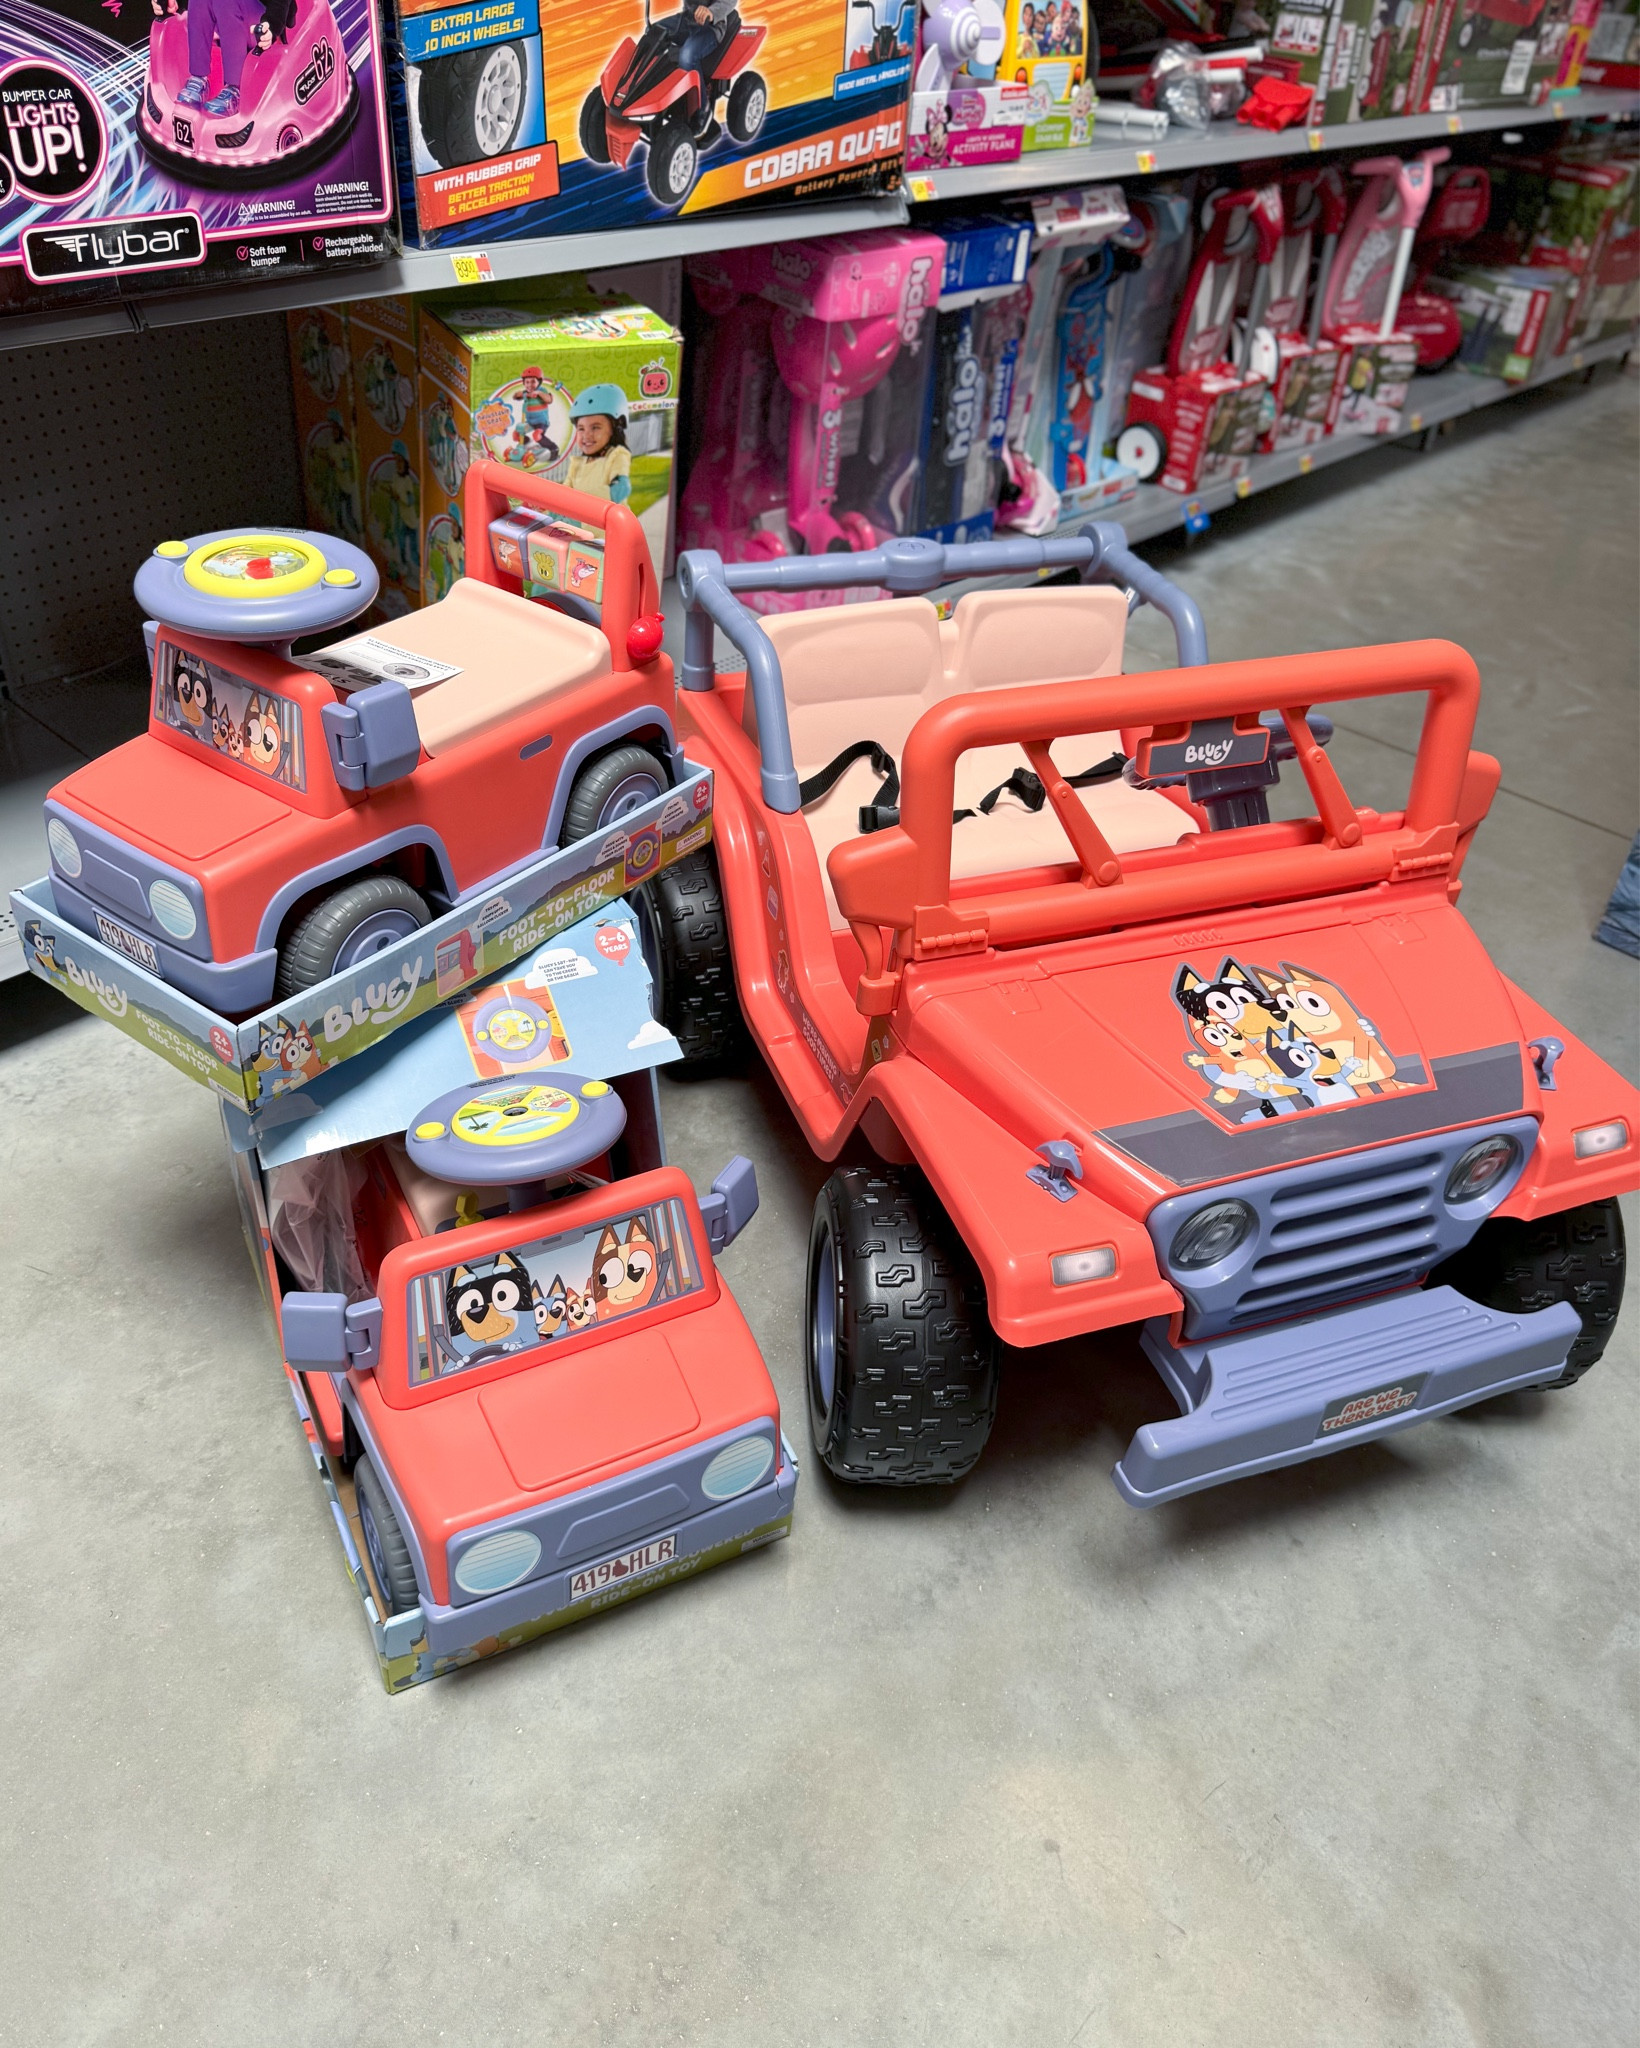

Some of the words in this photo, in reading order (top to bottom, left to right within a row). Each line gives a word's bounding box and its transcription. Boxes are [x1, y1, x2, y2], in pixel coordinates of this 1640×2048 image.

[430, 12, 473, 33] EXTRA
[475, 2, 516, 23] LARGE
[425, 37, 439, 53] 10
[440, 30, 470, 49] INCH
[473, 17, 525, 41] WHEELS!
[2, 89, 47, 103] BUMPER
[48, 88, 73, 101] CAR
[3, 101, 81, 128] LIGHTS
[176, 120, 191, 143] 62
[8, 123, 88, 177] UP!
[952, 140, 989, 155] ACTIVITY
[434, 173, 464, 193] WITH
[465, 161, 513, 184] RUBBER
[514, 153, 542, 172] GRIP
[744, 139, 834, 189] COBRA
[324, 181, 369, 195] WARNING!
[448, 185, 487, 204] BETTER
[488, 172, 535, 193] TRACTION
[448, 206, 457, 216] &
[458, 185, 530, 214] ACCELERATION
[794, 176, 836, 196] Battery
[248, 199, 296, 214] WARNING!
[43, 228, 189, 265] Flybar
[250, 247, 266, 258] Soft
[267, 245, 287, 255] foam
[324, 233, 374, 248] Rechargeable
[326, 247, 352, 258] battery
[352, 242, 384, 254] included
[251, 255, 281, 267] bumper
[902, 256, 934, 344] halo
[947, 358, 979, 462] halo
[1184, 739, 1234, 766] BLUEY
[697, 786, 707, 798] 2+
[498, 867, 616, 946] FOOT-TO-FLOOR
[513, 911, 574, 953] RIDE-ON
[577, 889, 603, 915] TOY
[100, 919, 122, 948] 419
[126, 937, 157, 970] HLR
[598, 931, 626, 947] 2-6
[603, 943, 628, 954] YEARS
[64, 956, 128, 1018] BLUEY
[324, 955, 423, 1043] BLUEY
[136, 1009, 218, 1071] FOOT-TO-FLOOR
[147, 1027, 190, 1063] RIDE-ON
[190, 1055, 210, 1075] TOY
[213, 1031, 229, 1048] 2+
[802, 1026, 817, 1053] GOOD
[1322, 1406, 1376, 1431] THERE
[1376, 1391, 1417, 1416] YET?
[1341, 1395, 1376, 1416] ARE
[1375, 1386, 1403, 1404] WE
[573, 1562, 612, 1593] 419
[628, 1539, 673, 1574] HLR
[591, 1570, 666, 1609] RIDE-ON
[670, 1556, 702, 1577] TOY
